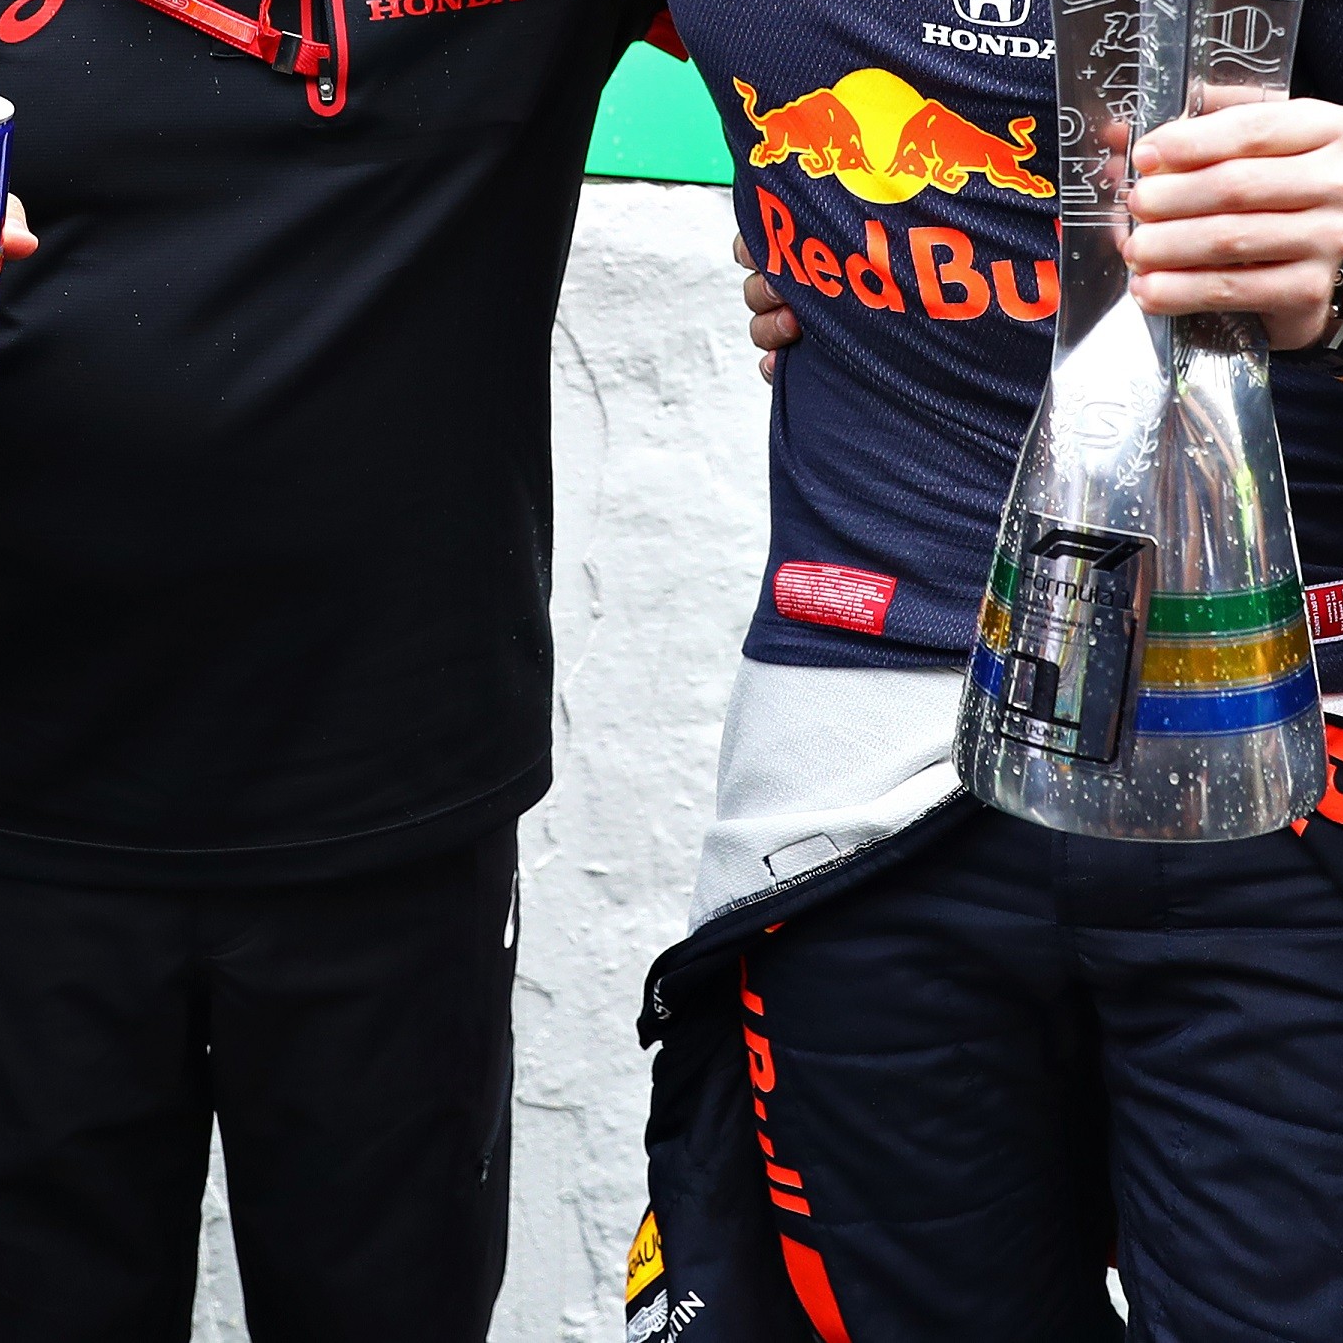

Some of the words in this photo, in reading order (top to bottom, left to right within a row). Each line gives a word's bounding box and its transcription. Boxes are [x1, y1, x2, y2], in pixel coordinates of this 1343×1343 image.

[922, 23, 1057, 60] HONDA
[755, 185, 904, 314] Red
[909, 217, 1060, 322] Bu
[1023, 566, 1114, 607] Formula
